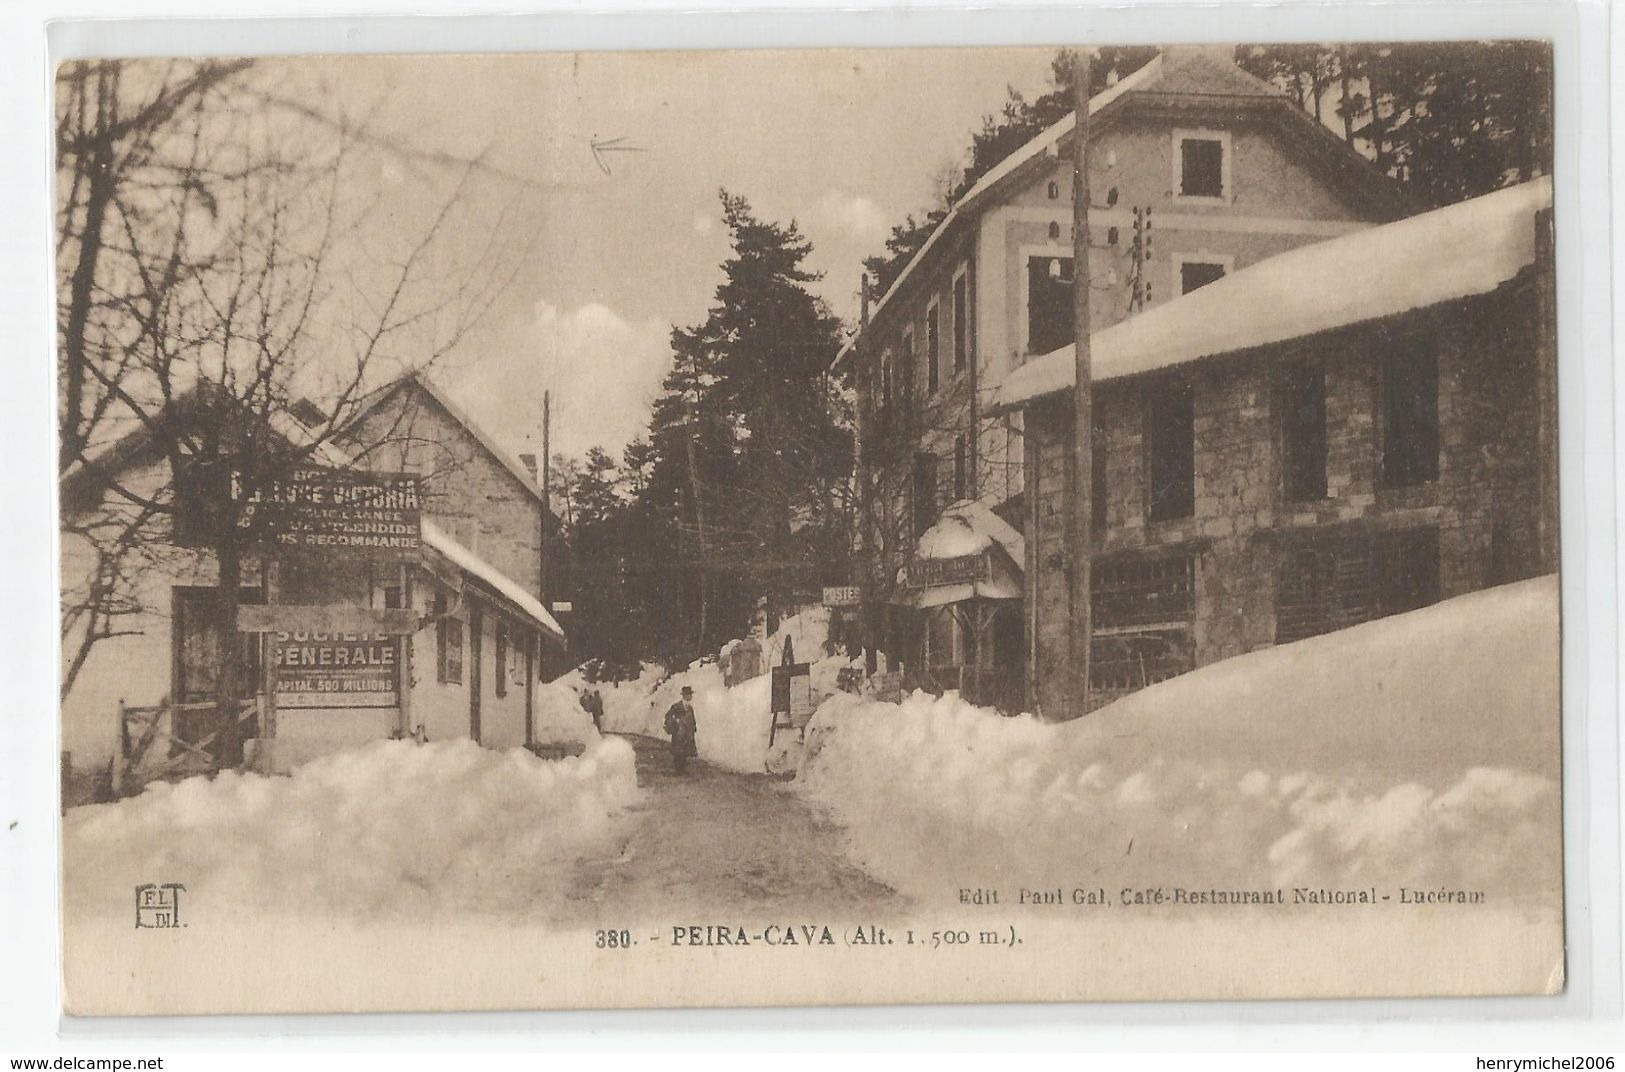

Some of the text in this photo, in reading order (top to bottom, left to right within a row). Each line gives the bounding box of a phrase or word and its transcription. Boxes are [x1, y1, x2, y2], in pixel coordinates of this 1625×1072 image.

[277, 679, 393, 692] APITAL 500 MILLIONS
